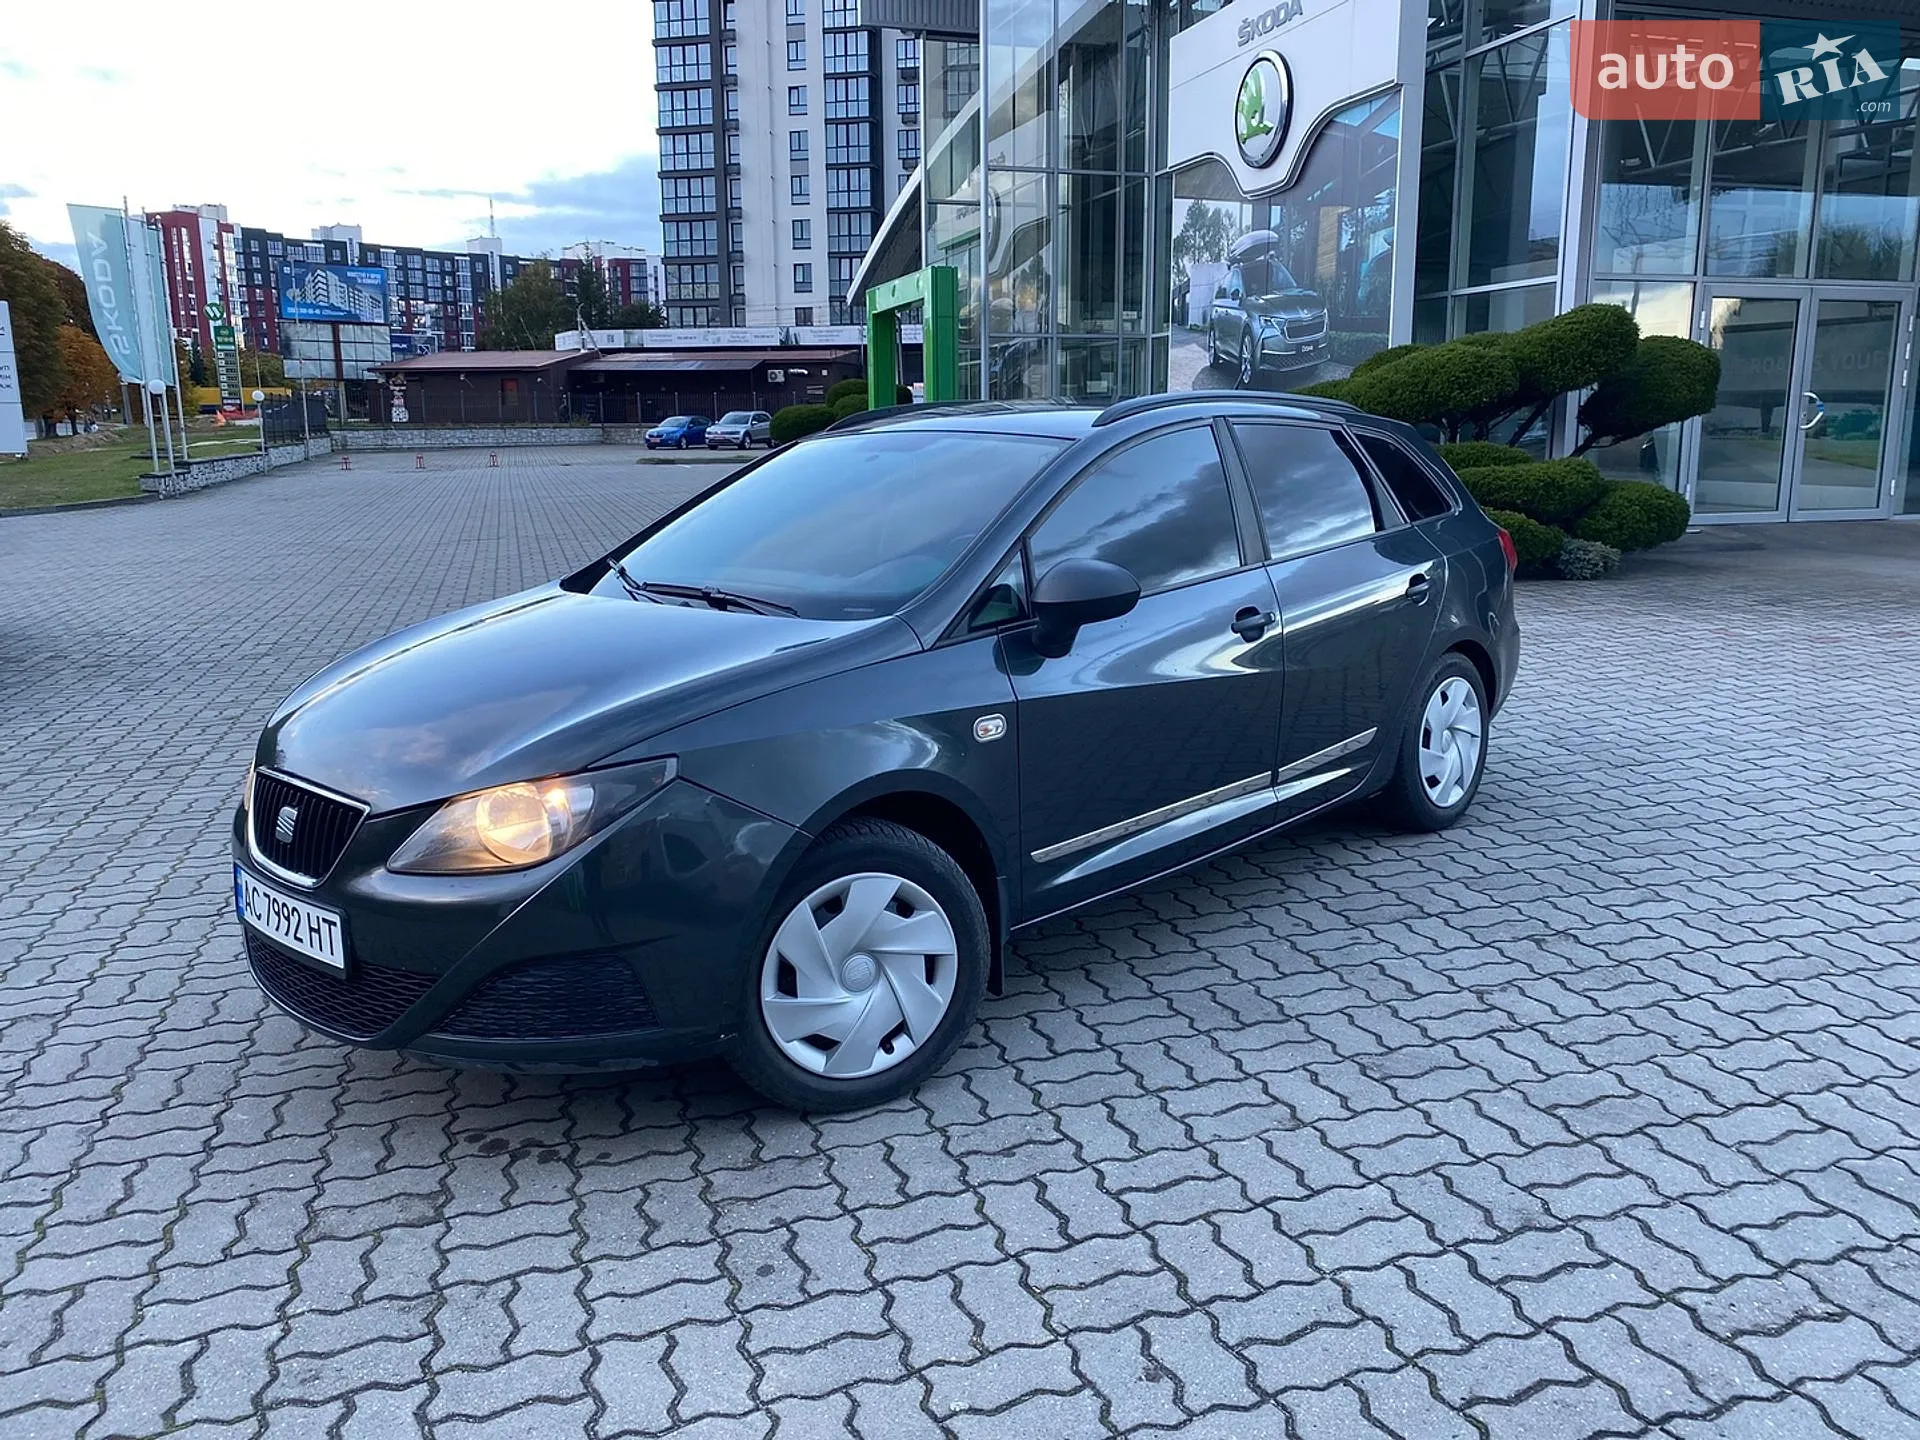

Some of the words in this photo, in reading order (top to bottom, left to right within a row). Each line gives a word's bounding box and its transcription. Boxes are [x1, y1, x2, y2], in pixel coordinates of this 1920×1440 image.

[1237, 0, 1303, 47] ŠKODA
[245, 880, 262, 921] AC
[263, 892, 304, 943] 7992
[307, 912, 337, 956] HT
